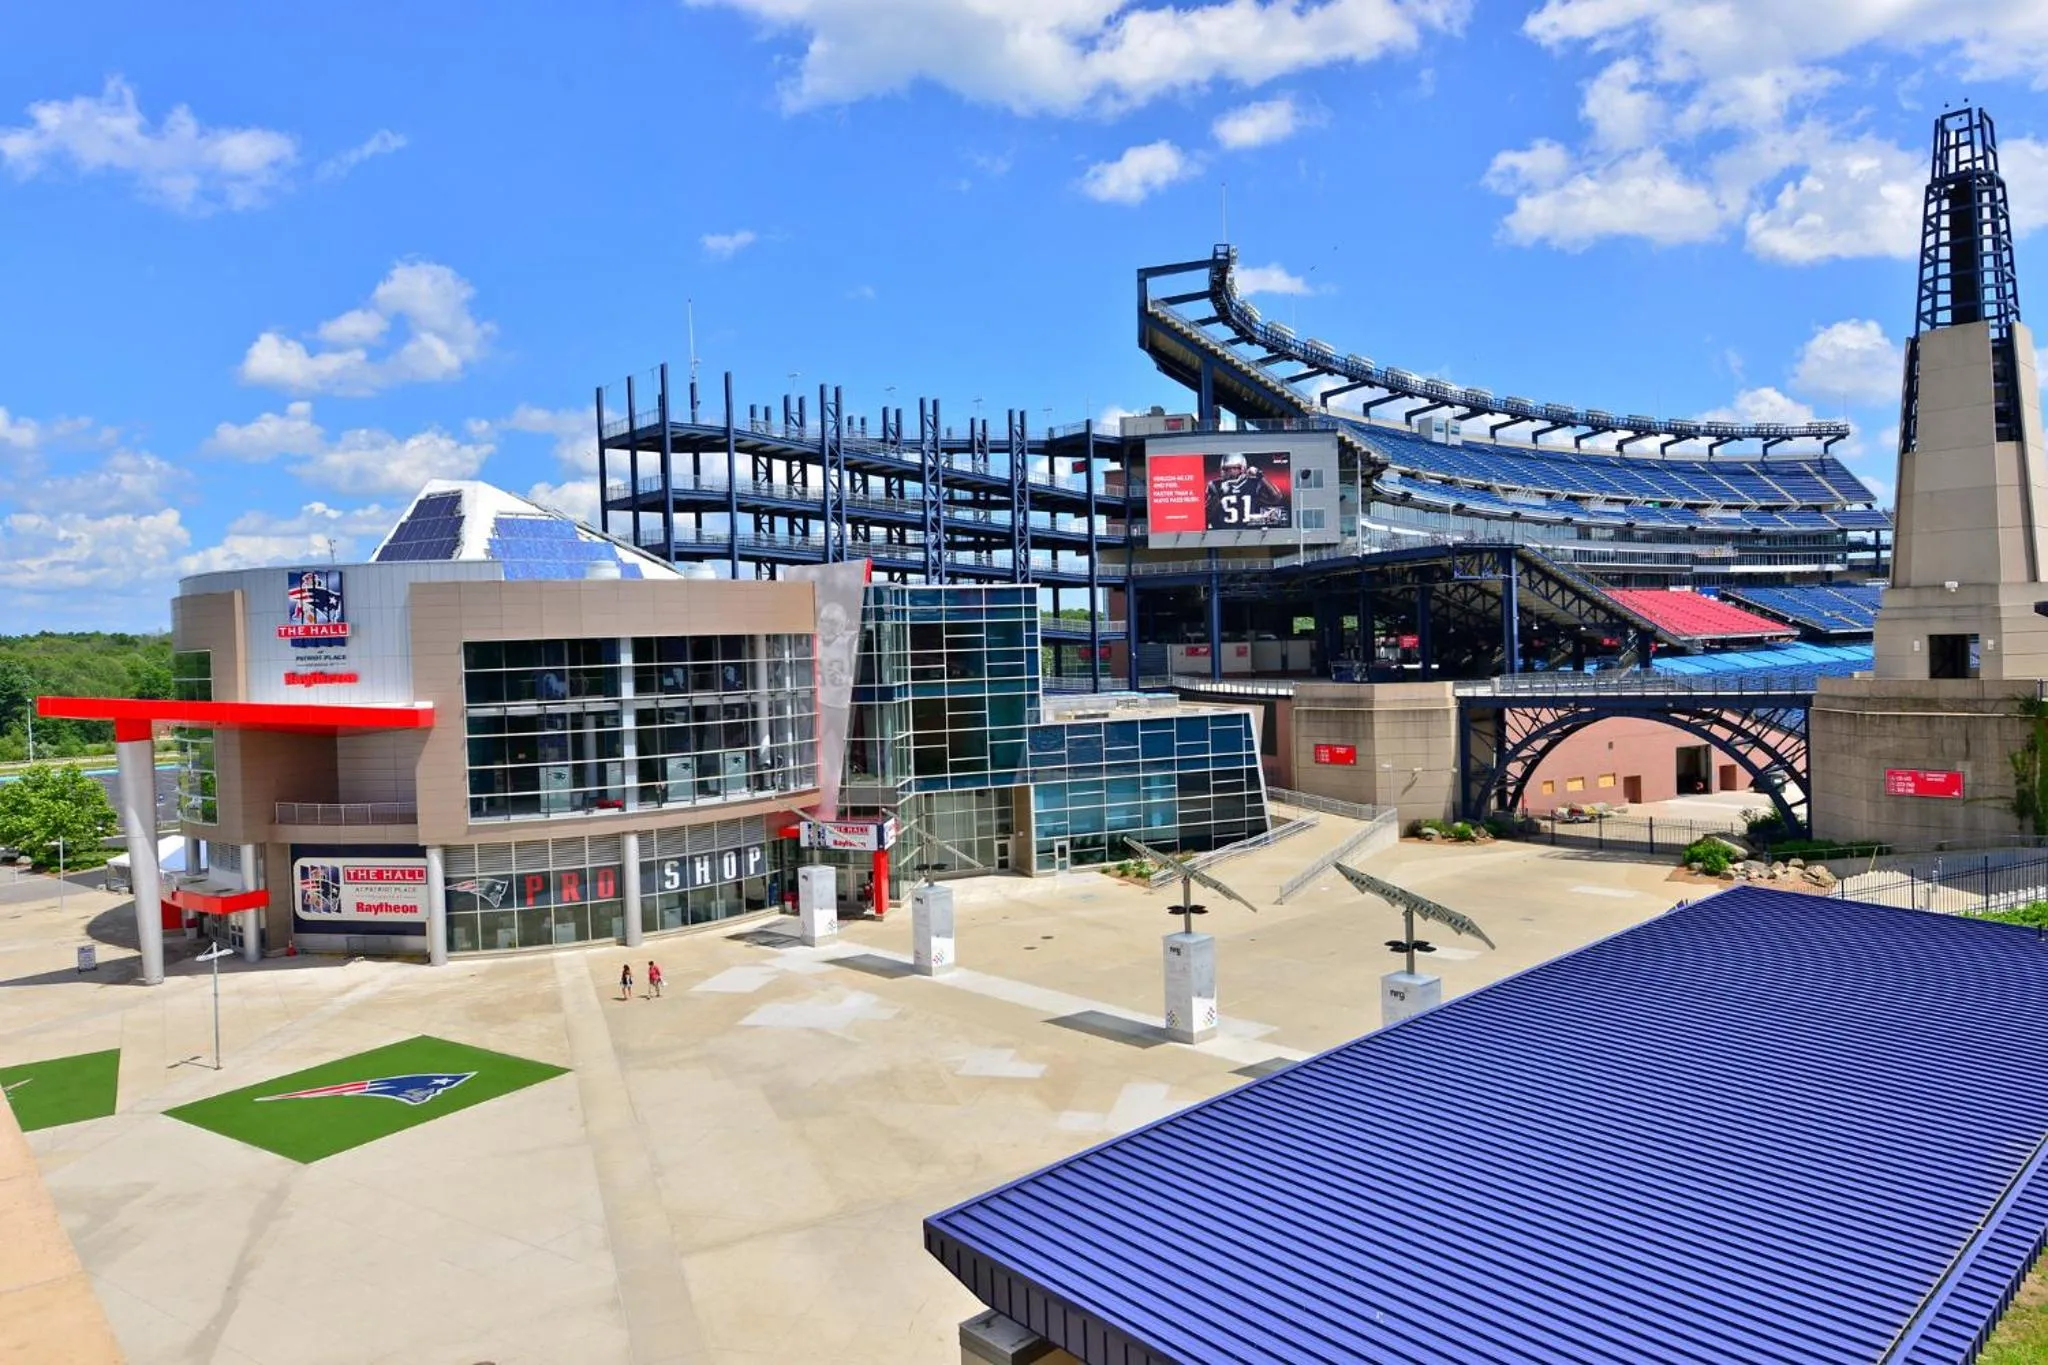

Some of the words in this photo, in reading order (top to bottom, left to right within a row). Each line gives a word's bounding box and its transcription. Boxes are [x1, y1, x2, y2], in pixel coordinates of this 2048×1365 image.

[1221, 495, 1251, 524] 51
[279, 626, 305, 637] THE
[310, 624, 346, 635] HALL
[348, 870, 378, 880] THE
[383, 870, 424, 880] HALL
[663, 848, 761, 890] SHOP
[525, 869, 615, 906] PRO
[356, 902, 418, 915] Raytheon
[1390, 989, 1405, 1001] nrg
